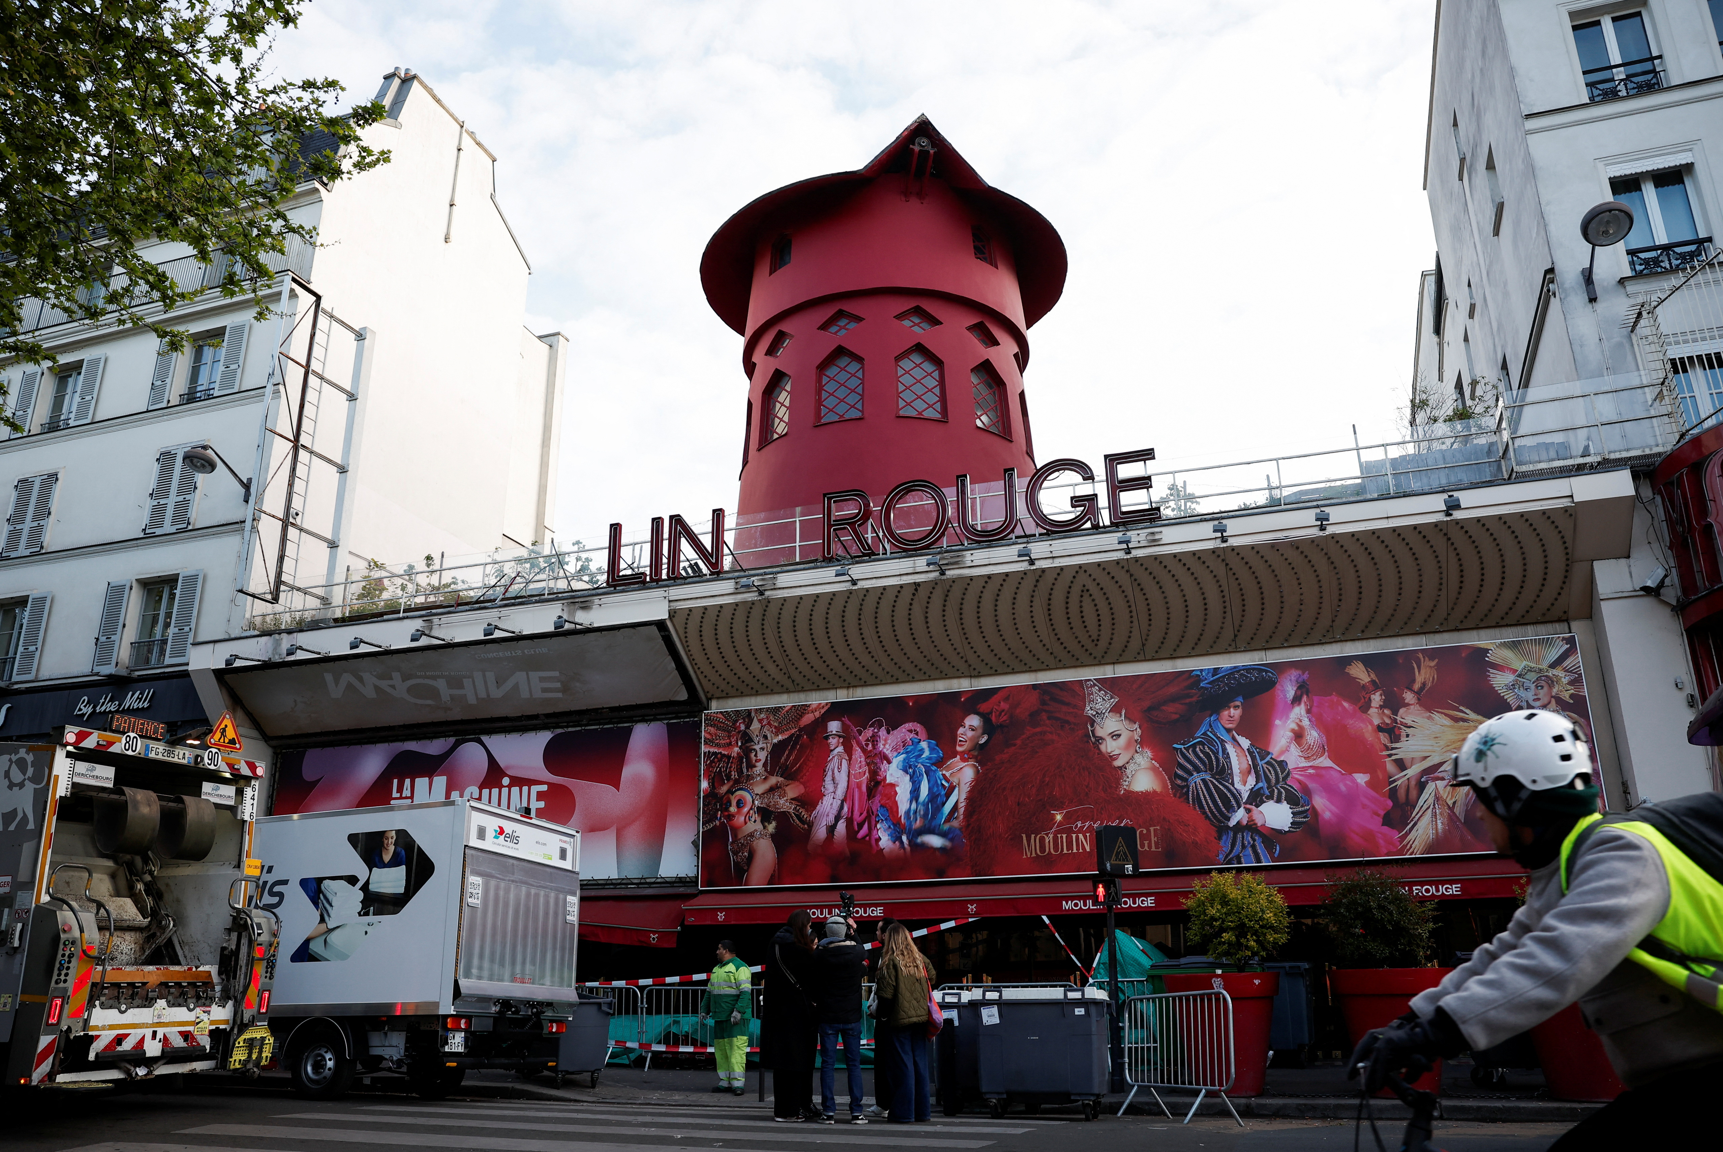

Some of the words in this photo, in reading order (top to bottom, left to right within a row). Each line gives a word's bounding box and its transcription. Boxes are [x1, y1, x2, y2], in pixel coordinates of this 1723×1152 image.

[605, 508, 725, 588] LIN
[821, 447, 1162, 561] ROUGE
[73, 695, 94, 721] By
[95, 692, 120, 713] the
[119, 688, 154, 711] Mill
[112, 714, 166, 739] PATIENCE
[123, 734, 138, 753] 80
[149, 746, 186, 761] FG-285-LA
[206, 750, 220, 767] 90
[74, 771, 113, 782] DERICHEBOURG
[202, 791, 234, 800] DERICHEBOURG
[391, 778, 411, 798] LA
[503, 829, 521, 845] elis
[1021, 833, 1091, 859] MOULIN
[1413, 884, 1461, 896] ROUGE
[807, 908, 841, 918] OULIN
[851, 906, 884, 918] OUGE
[1062, 899, 1107, 910] MOUL
